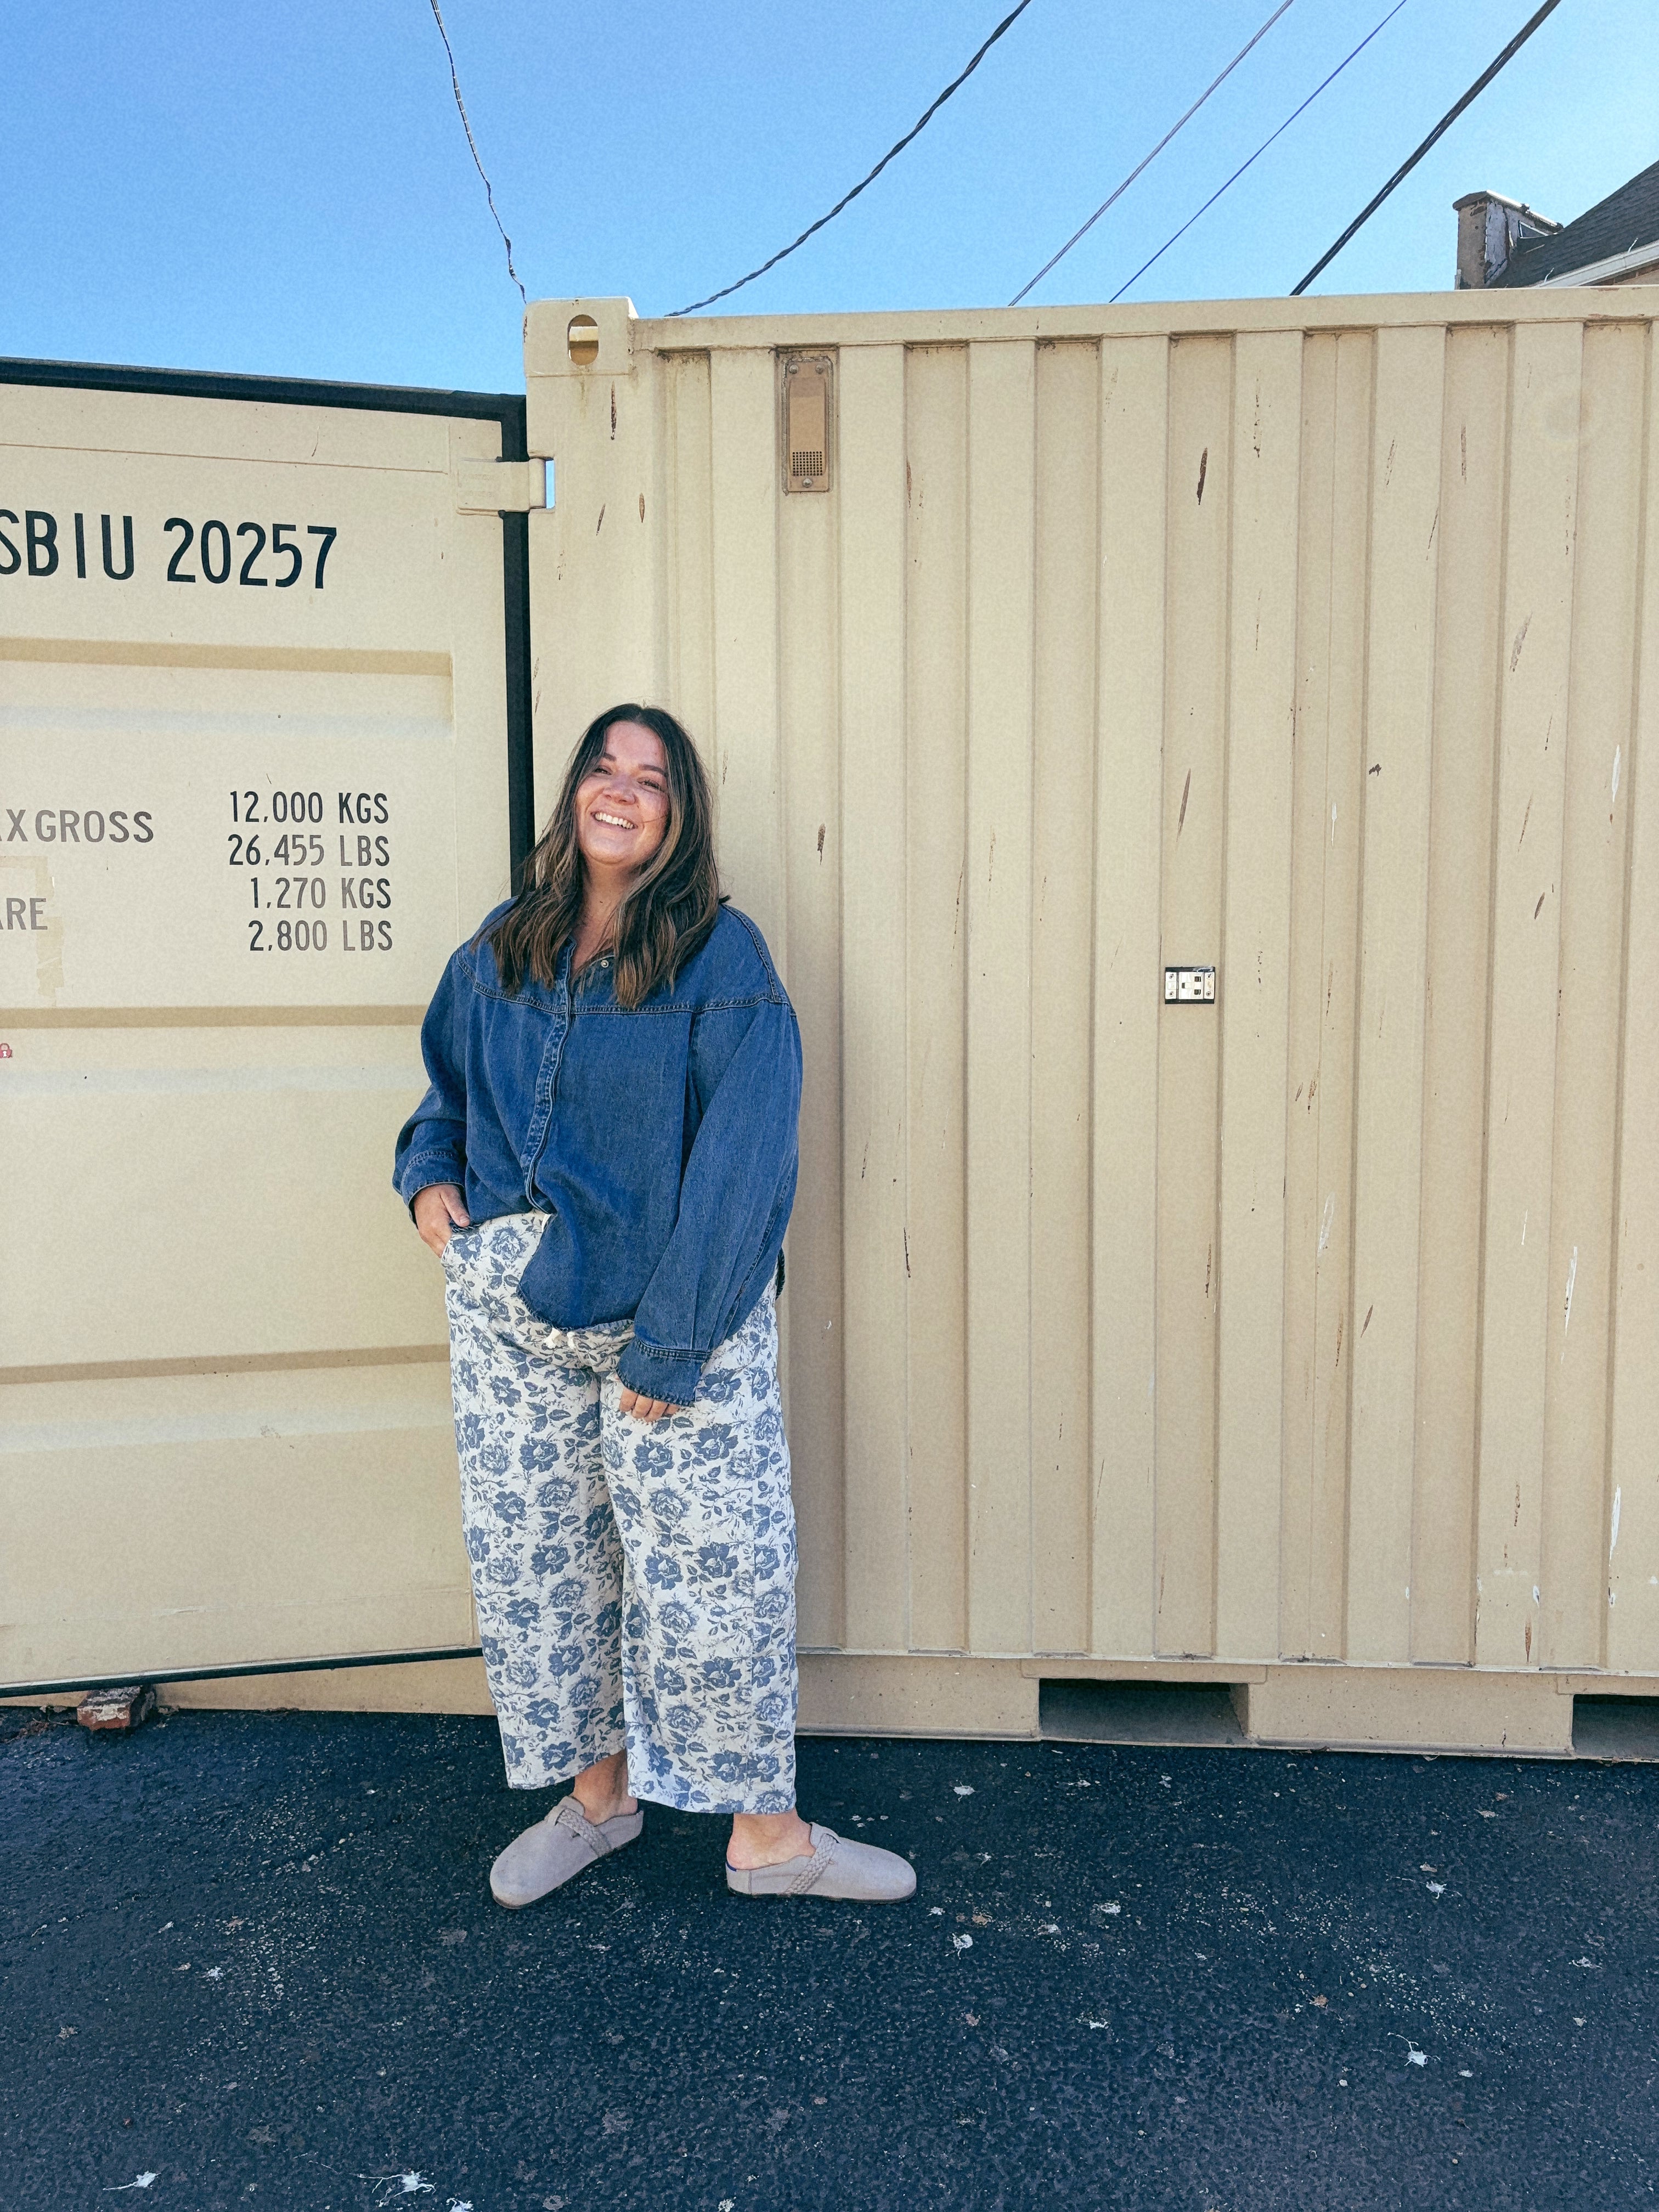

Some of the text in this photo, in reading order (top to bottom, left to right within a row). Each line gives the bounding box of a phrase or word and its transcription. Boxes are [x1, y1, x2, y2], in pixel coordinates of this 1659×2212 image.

[0, 508, 337, 590] SBIU 20257
[229, 791, 389, 824] 12,000 KGS
[0, 809, 154, 843] X GROSS
[227, 833, 390, 867] 26,455 LBS
[250, 877, 392, 909] 1,270 KGS
[0, 898, 48, 930] RE
[248, 919, 393, 951] 2,800 LBS
